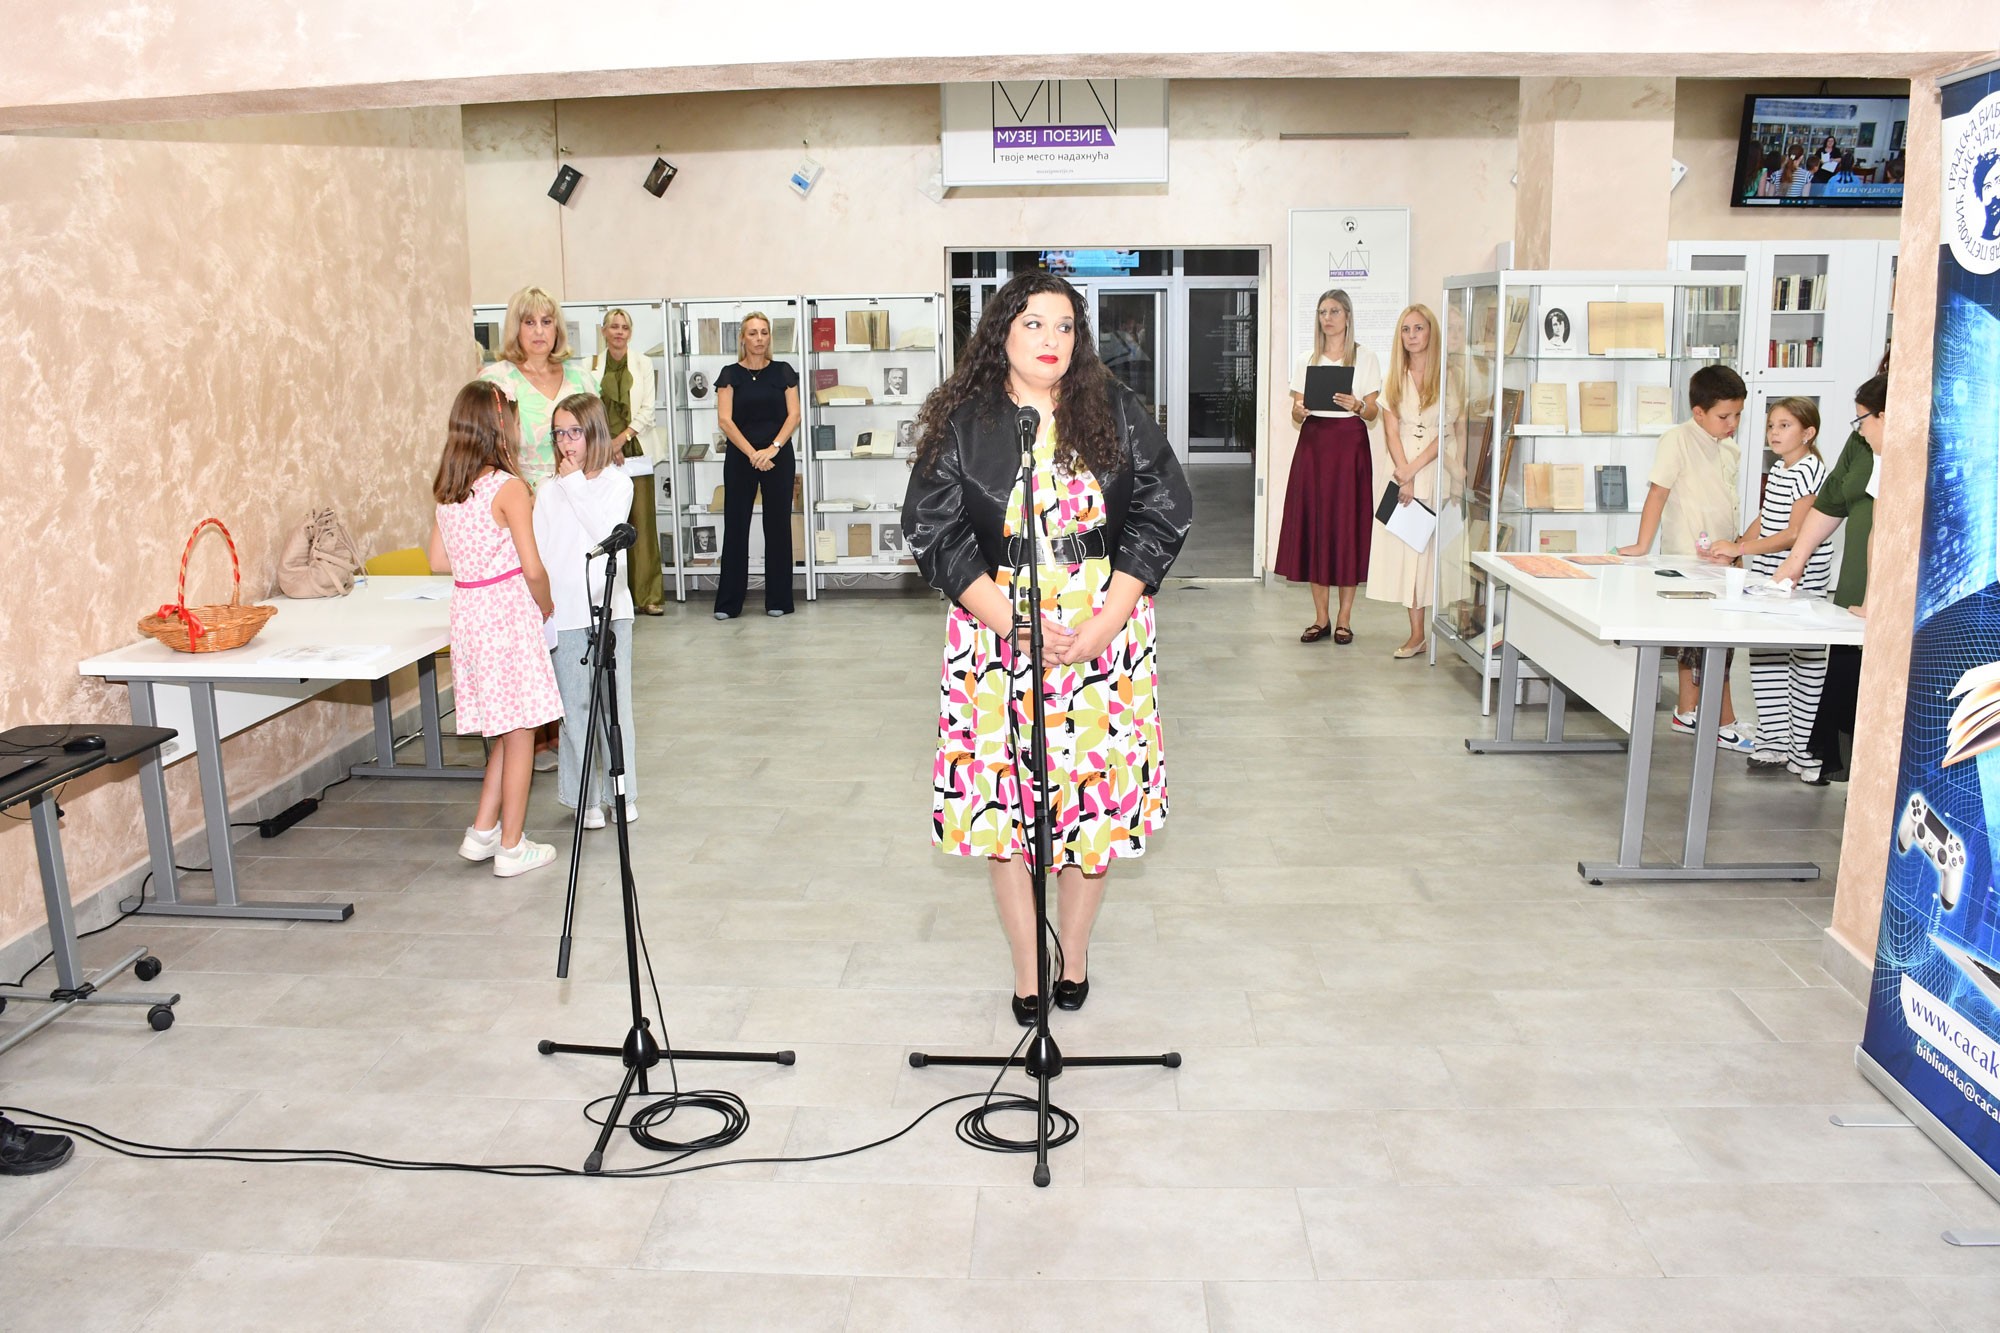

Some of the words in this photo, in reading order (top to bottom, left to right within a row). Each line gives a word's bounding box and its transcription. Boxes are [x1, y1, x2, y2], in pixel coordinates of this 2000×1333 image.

[997, 129, 1037, 145] МУЗЕЈ
[1043, 128, 1102, 144] ПОЕЗИЈЕ
[1000, 153, 1025, 163] твоје
[1027, 152, 1055, 162] место
[1057, 151, 1109, 162] надахнућа
